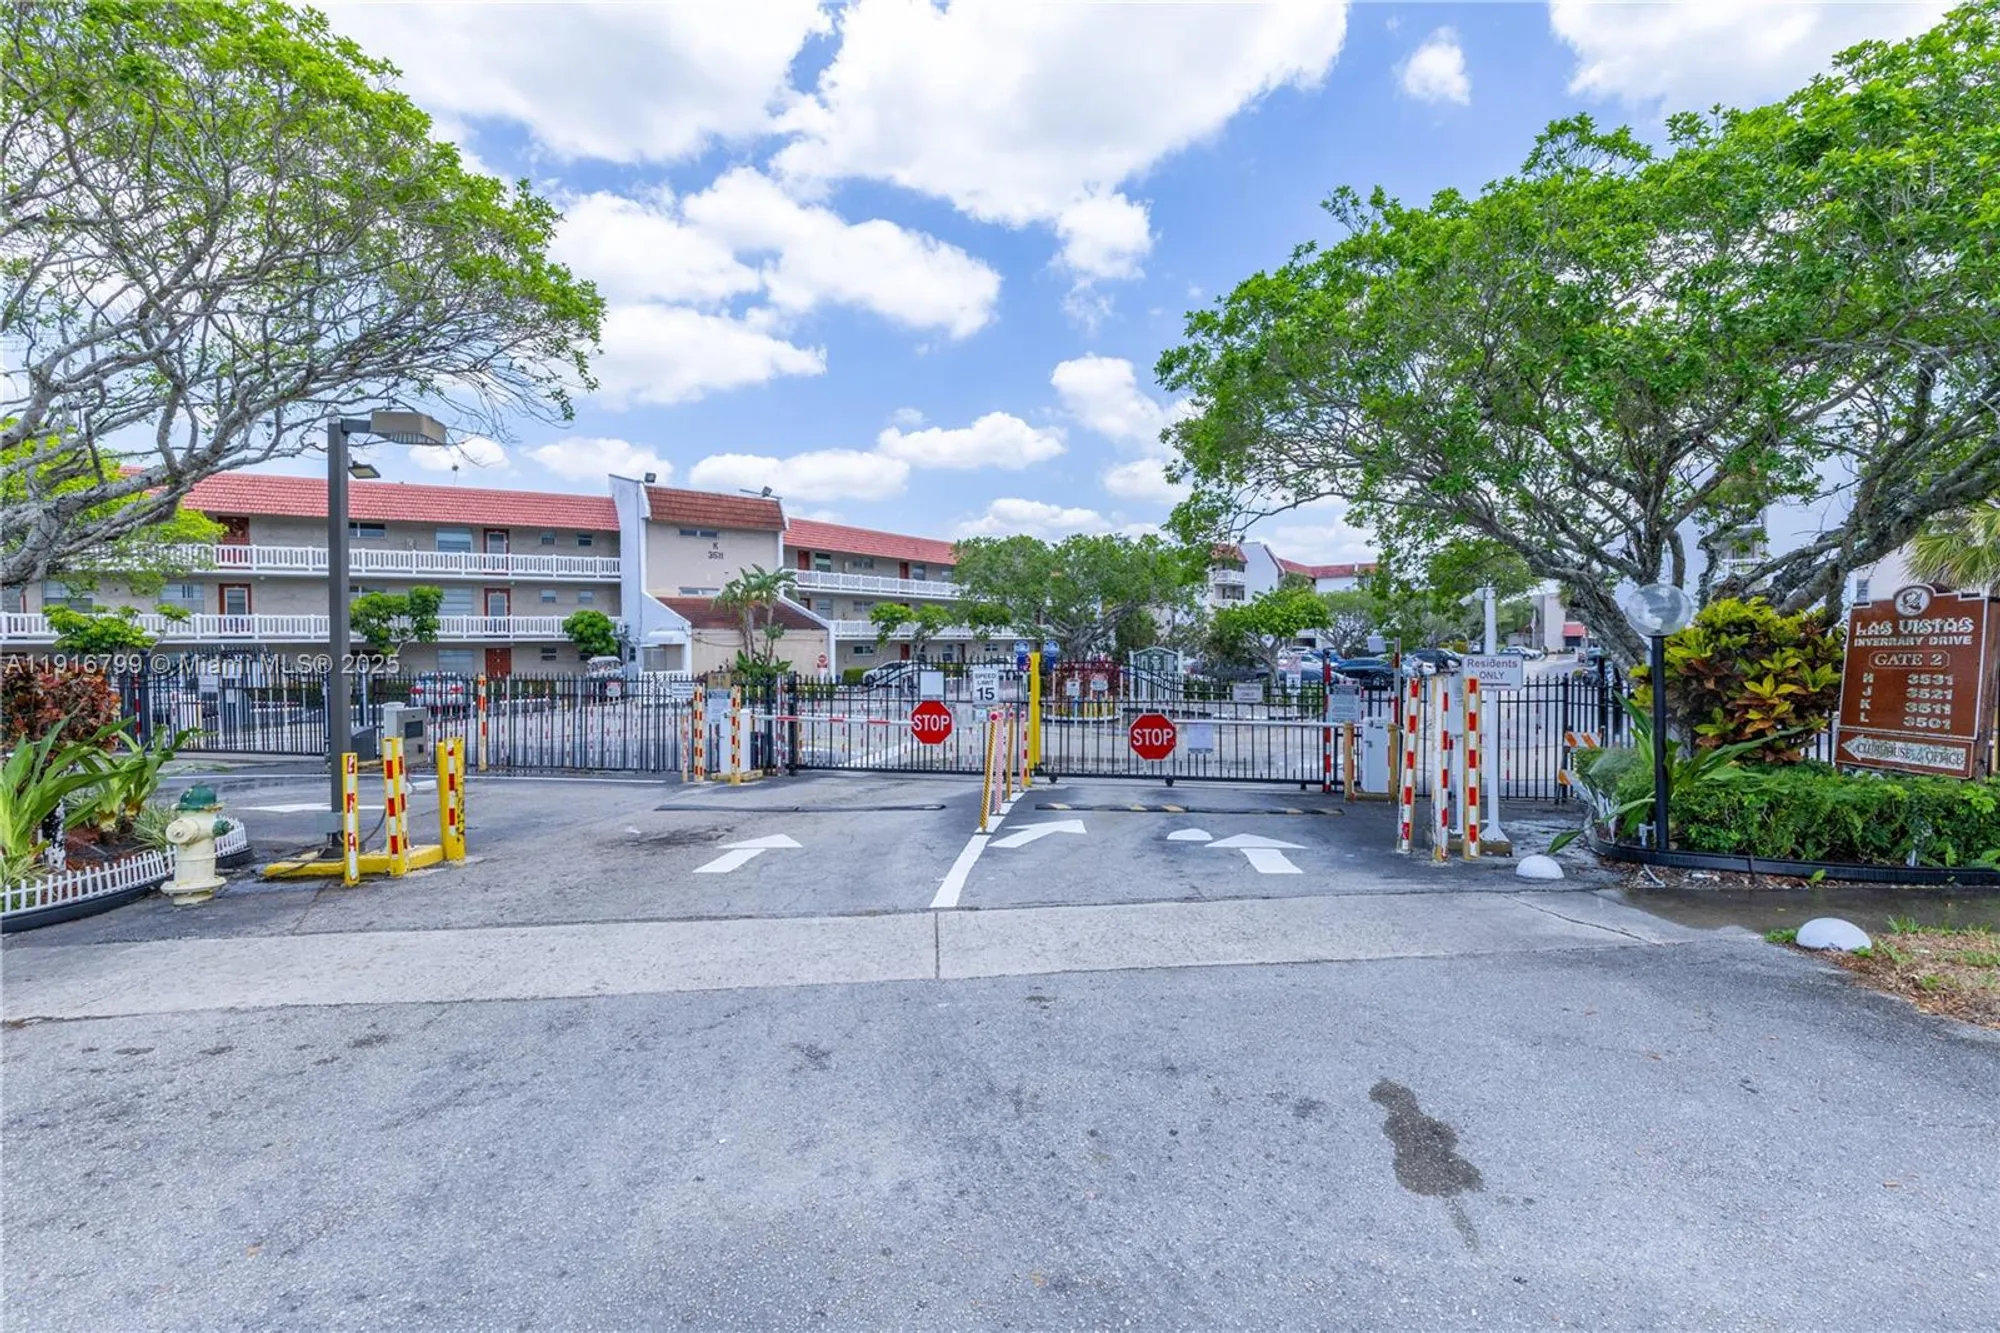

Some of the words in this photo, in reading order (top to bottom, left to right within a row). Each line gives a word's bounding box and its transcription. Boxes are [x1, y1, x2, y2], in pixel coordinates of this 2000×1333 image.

[1856, 621, 1893, 636] LAS
[1900, 617, 1975, 634] VISTAS
[1854, 637, 1924, 647] INVERRARY
[1929, 635, 1973, 646] DRIVE
[1466, 658, 1518, 669] Residents
[1874, 653, 1922, 666] GATE
[1930, 654, 1942, 666] 2
[1479, 671, 1505, 680] ONLY
[1862, 672, 1874, 683] H
[1907, 674, 1954, 686] 3531
[976, 687, 995, 701] 15
[1861, 686, 1873, 697] J
[1905, 687, 1953, 700] 3521
[1859, 699, 1871, 710] K
[913, 714, 950, 732] STOP
[1859, 712, 1870, 723] L
[1133, 728, 1174, 746] STOP
